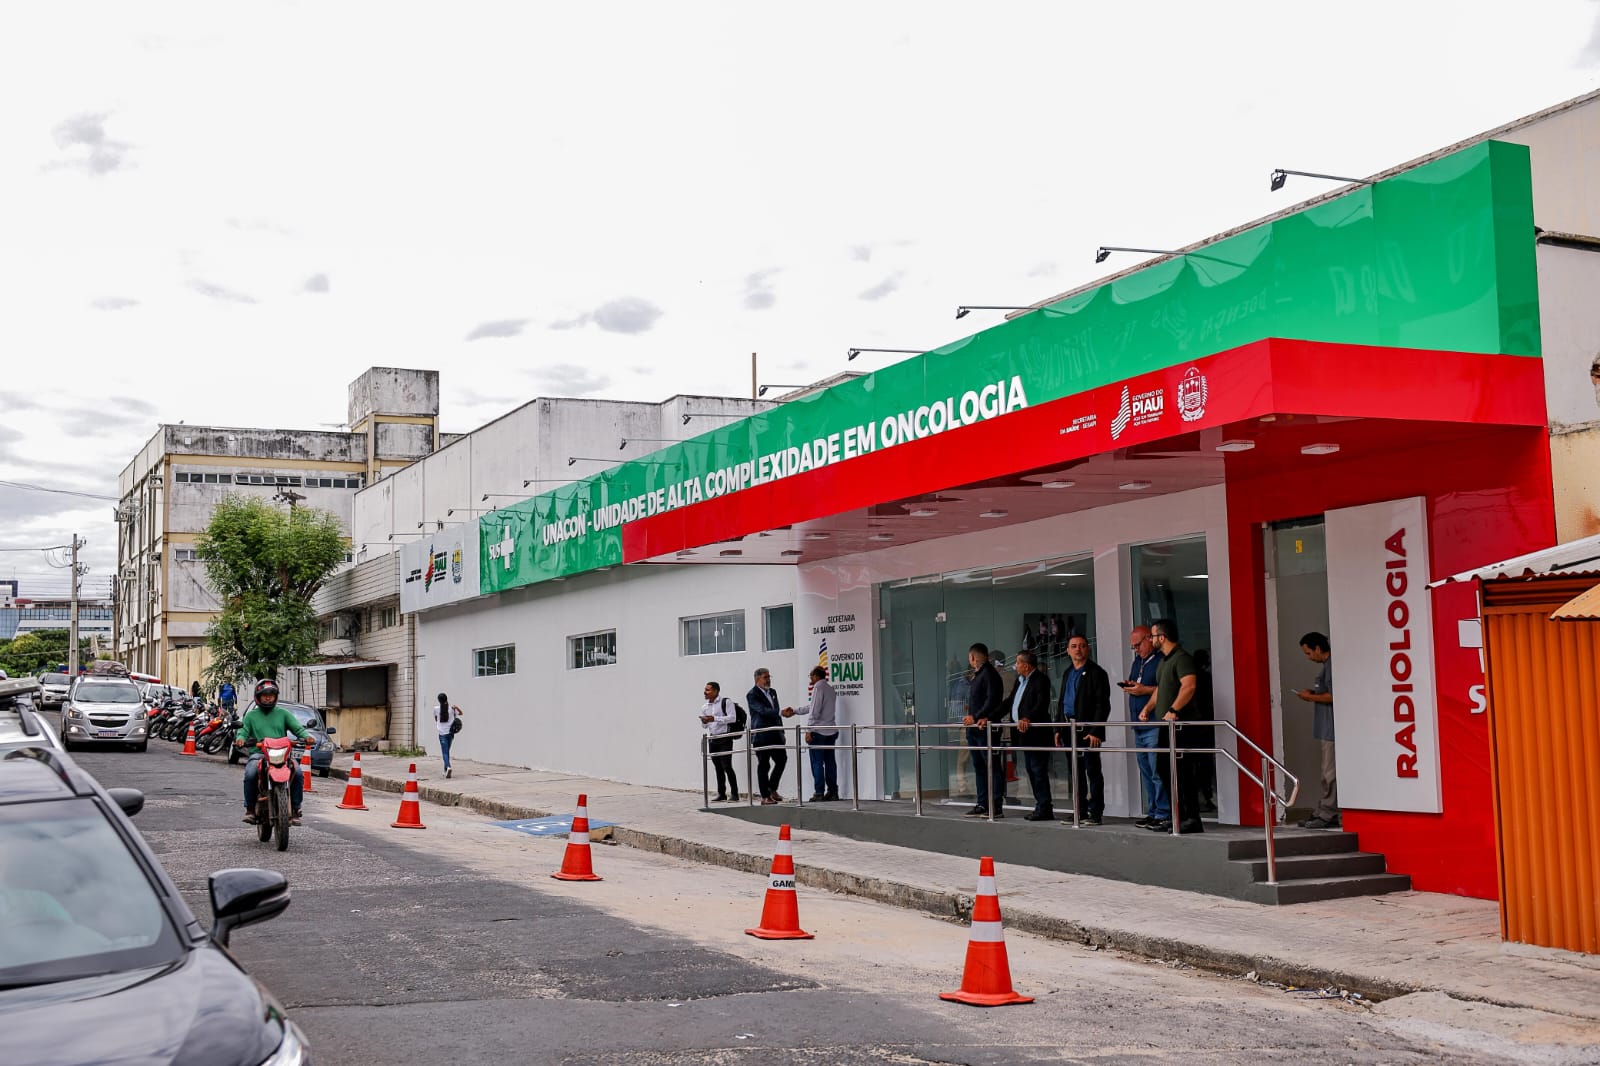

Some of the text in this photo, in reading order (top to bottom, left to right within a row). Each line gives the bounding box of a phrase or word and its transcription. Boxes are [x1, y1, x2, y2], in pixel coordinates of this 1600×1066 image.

[543, 513, 586, 546] UNACON
[593, 495, 647, 532] UNIDADE
[648, 488, 665, 515] DE
[667, 476, 703, 511] ALTA
[704, 432, 840, 499] COMPLEXIDADE
[843, 418, 876, 459] EM
[881, 375, 1028, 448] ONCOLOGIA
[831, 652, 864, 661] GOVERNO DO
[1385, 528, 1418, 778] RADIOLOGIA
